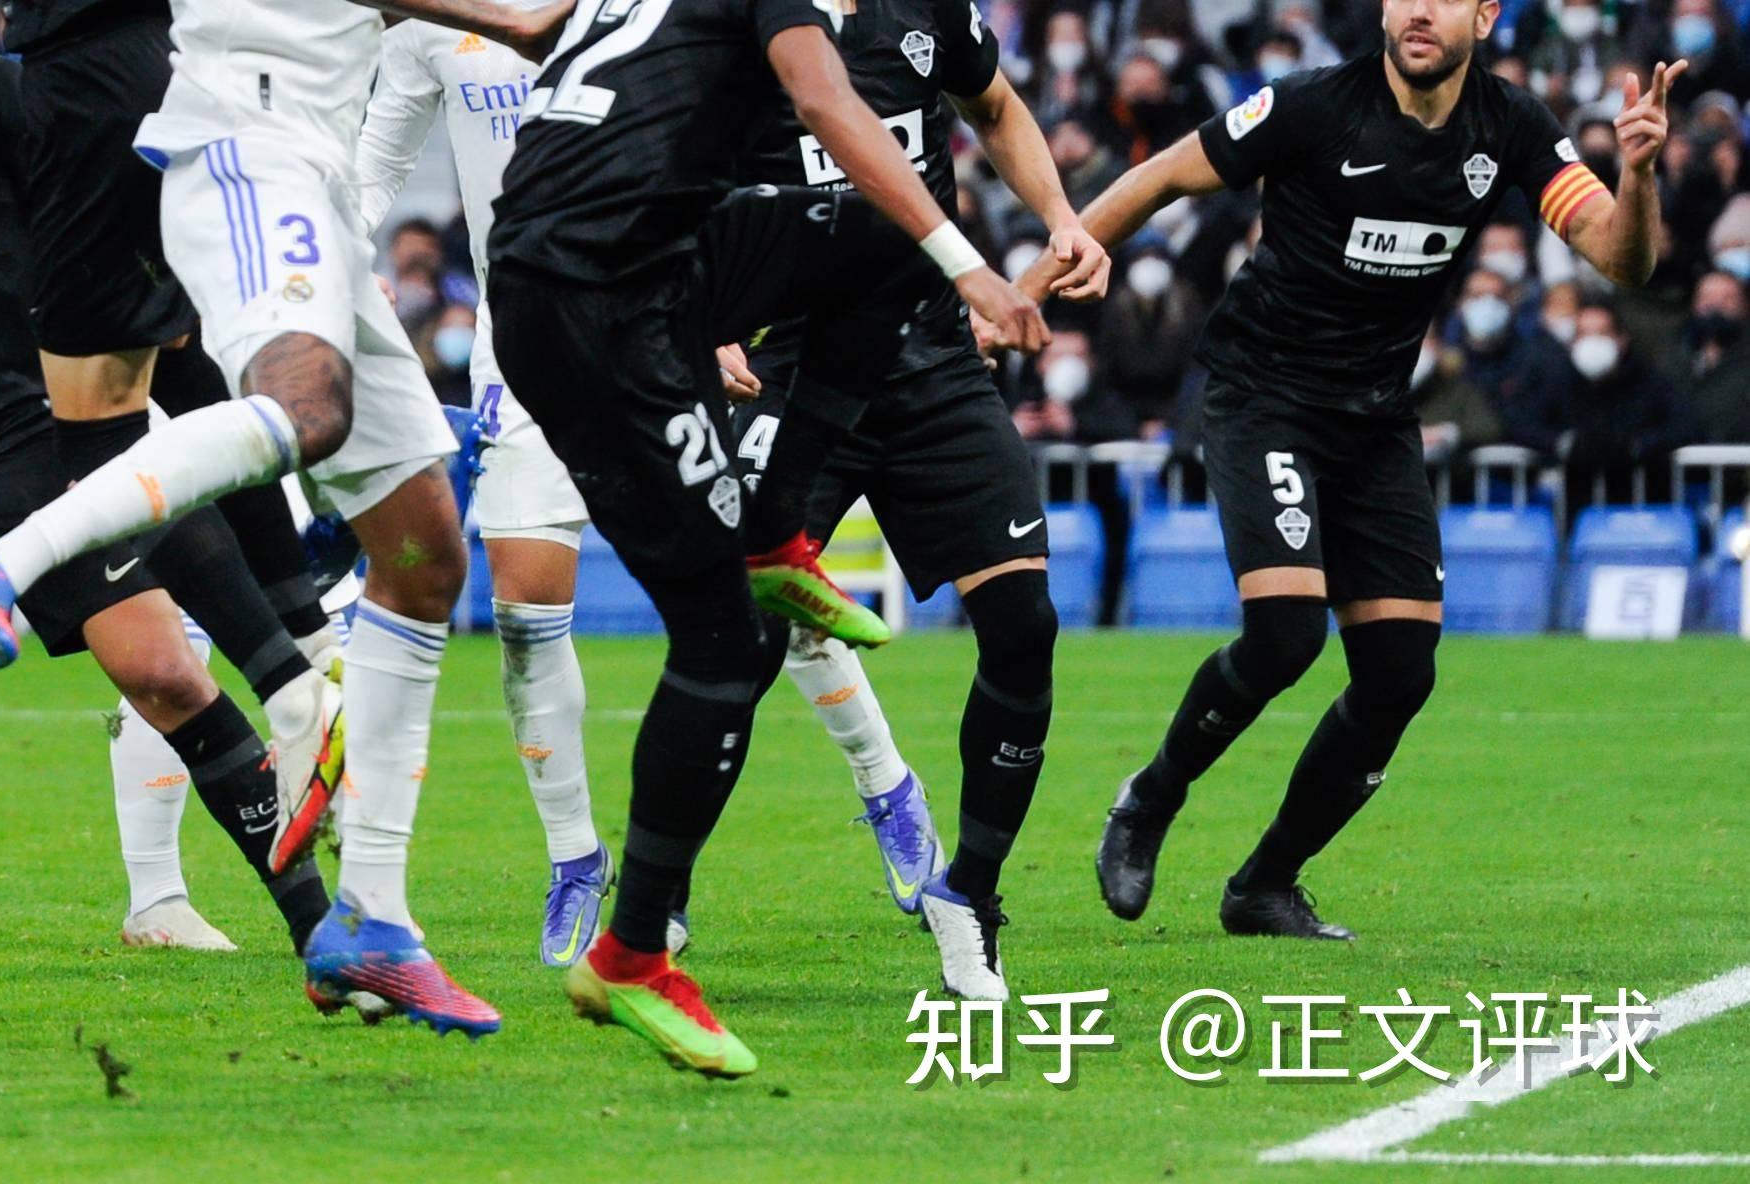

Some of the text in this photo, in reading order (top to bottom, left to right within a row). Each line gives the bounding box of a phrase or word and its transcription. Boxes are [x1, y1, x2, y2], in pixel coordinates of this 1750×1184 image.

[275, 213, 321, 267] 3
[1360, 230, 1398, 253] TM
[1363, 263, 1389, 276] Real
[1265, 451, 1305, 505] 5
